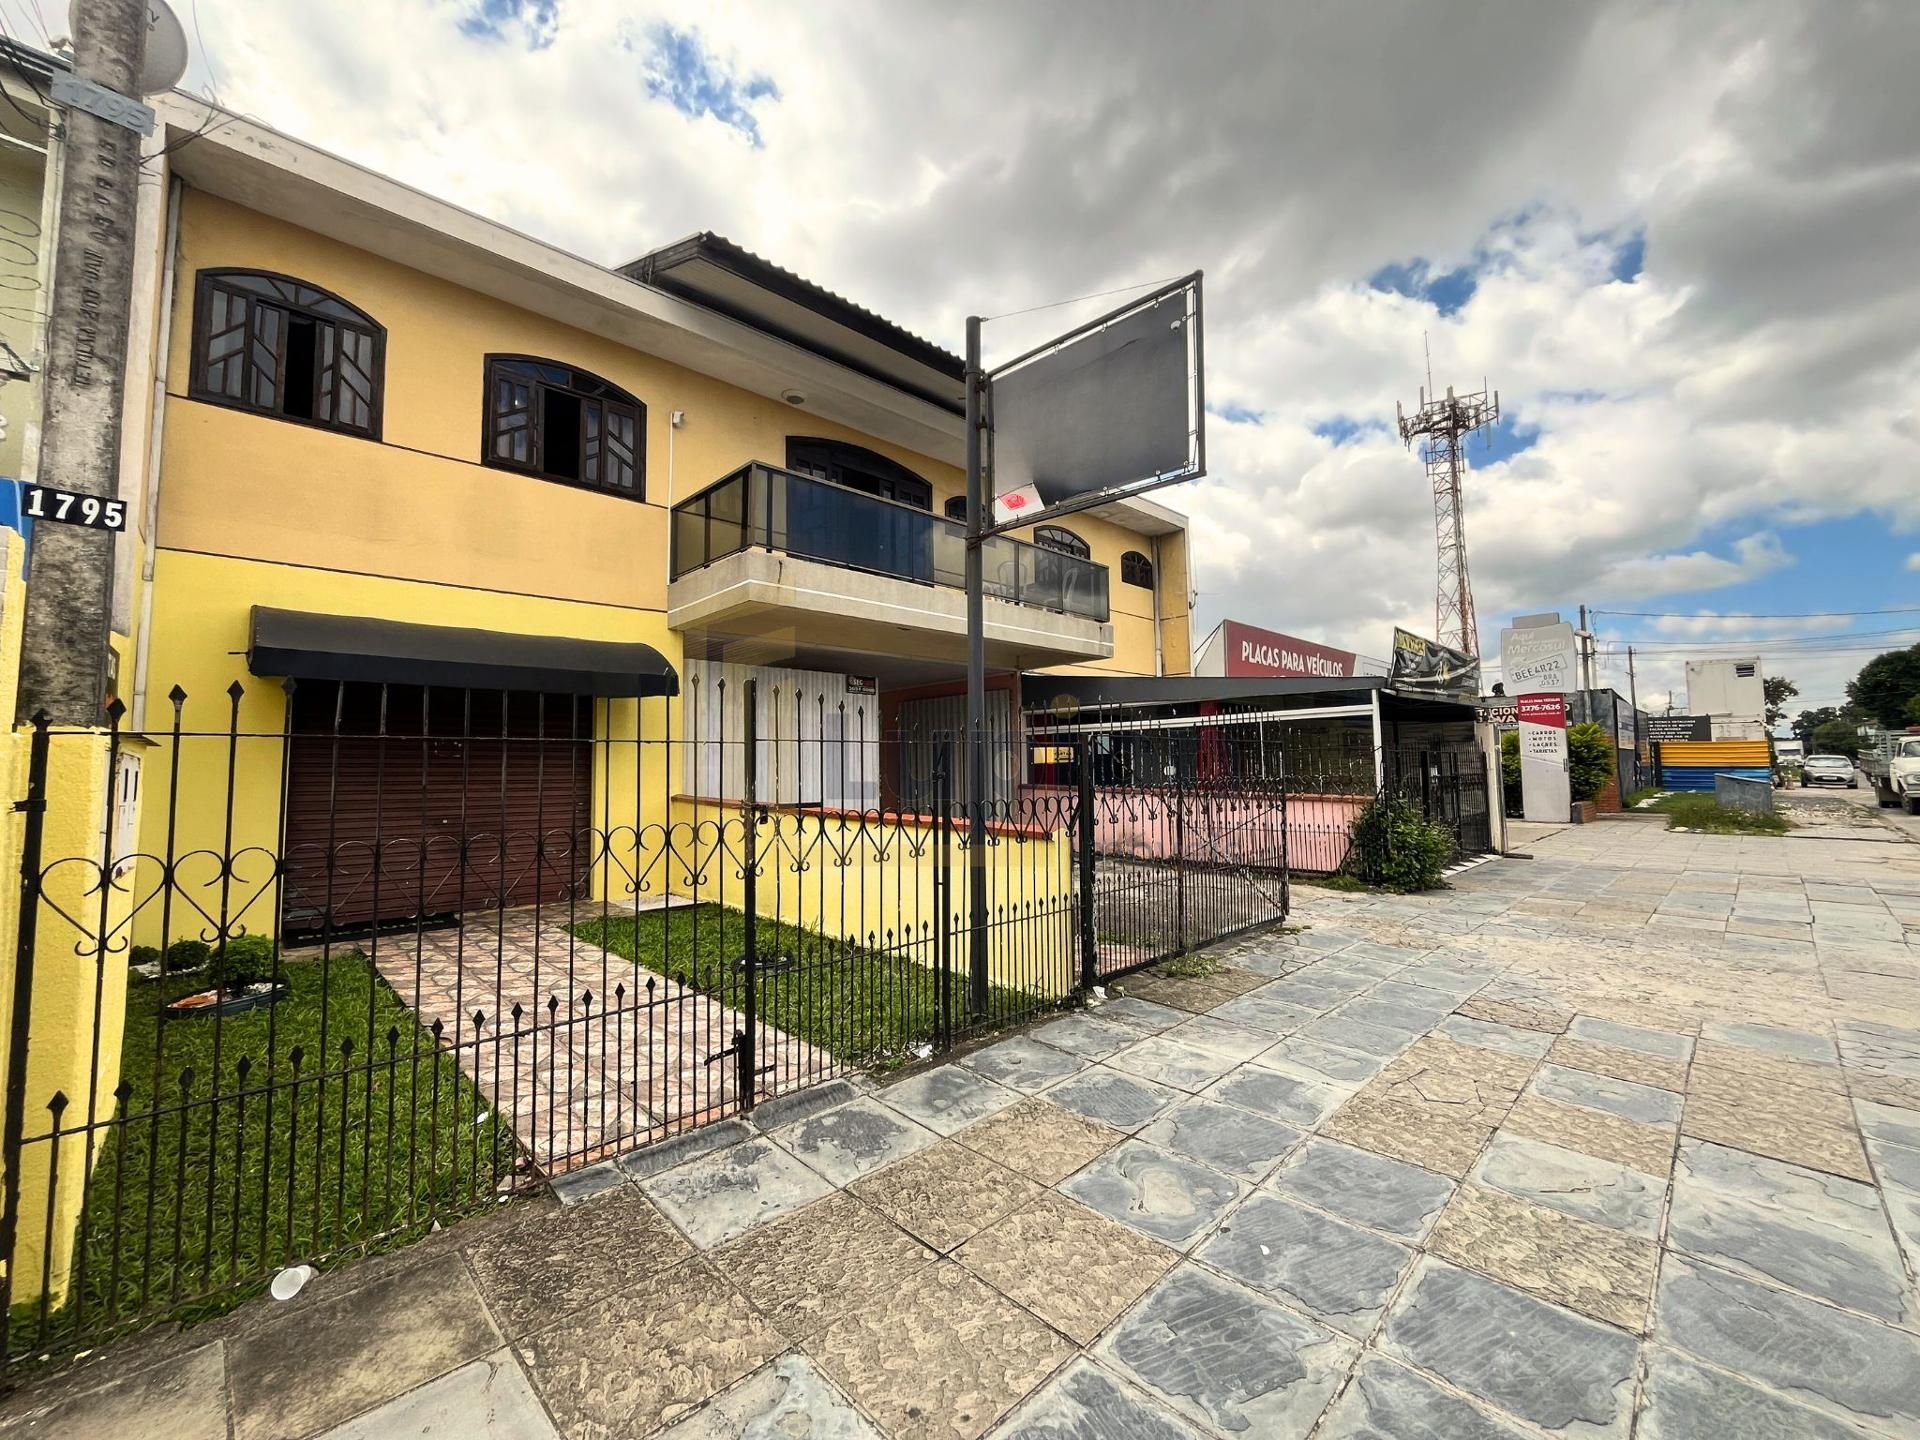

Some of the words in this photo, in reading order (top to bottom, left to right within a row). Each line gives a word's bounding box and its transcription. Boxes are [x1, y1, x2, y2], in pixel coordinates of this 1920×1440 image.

[28, 489, 123, 528] 1795
[1242, 640, 1280, 668] PLACAS
[1281, 650, 1305, 673] PARA
[1306, 653, 1343, 677] VEÍCULOS
